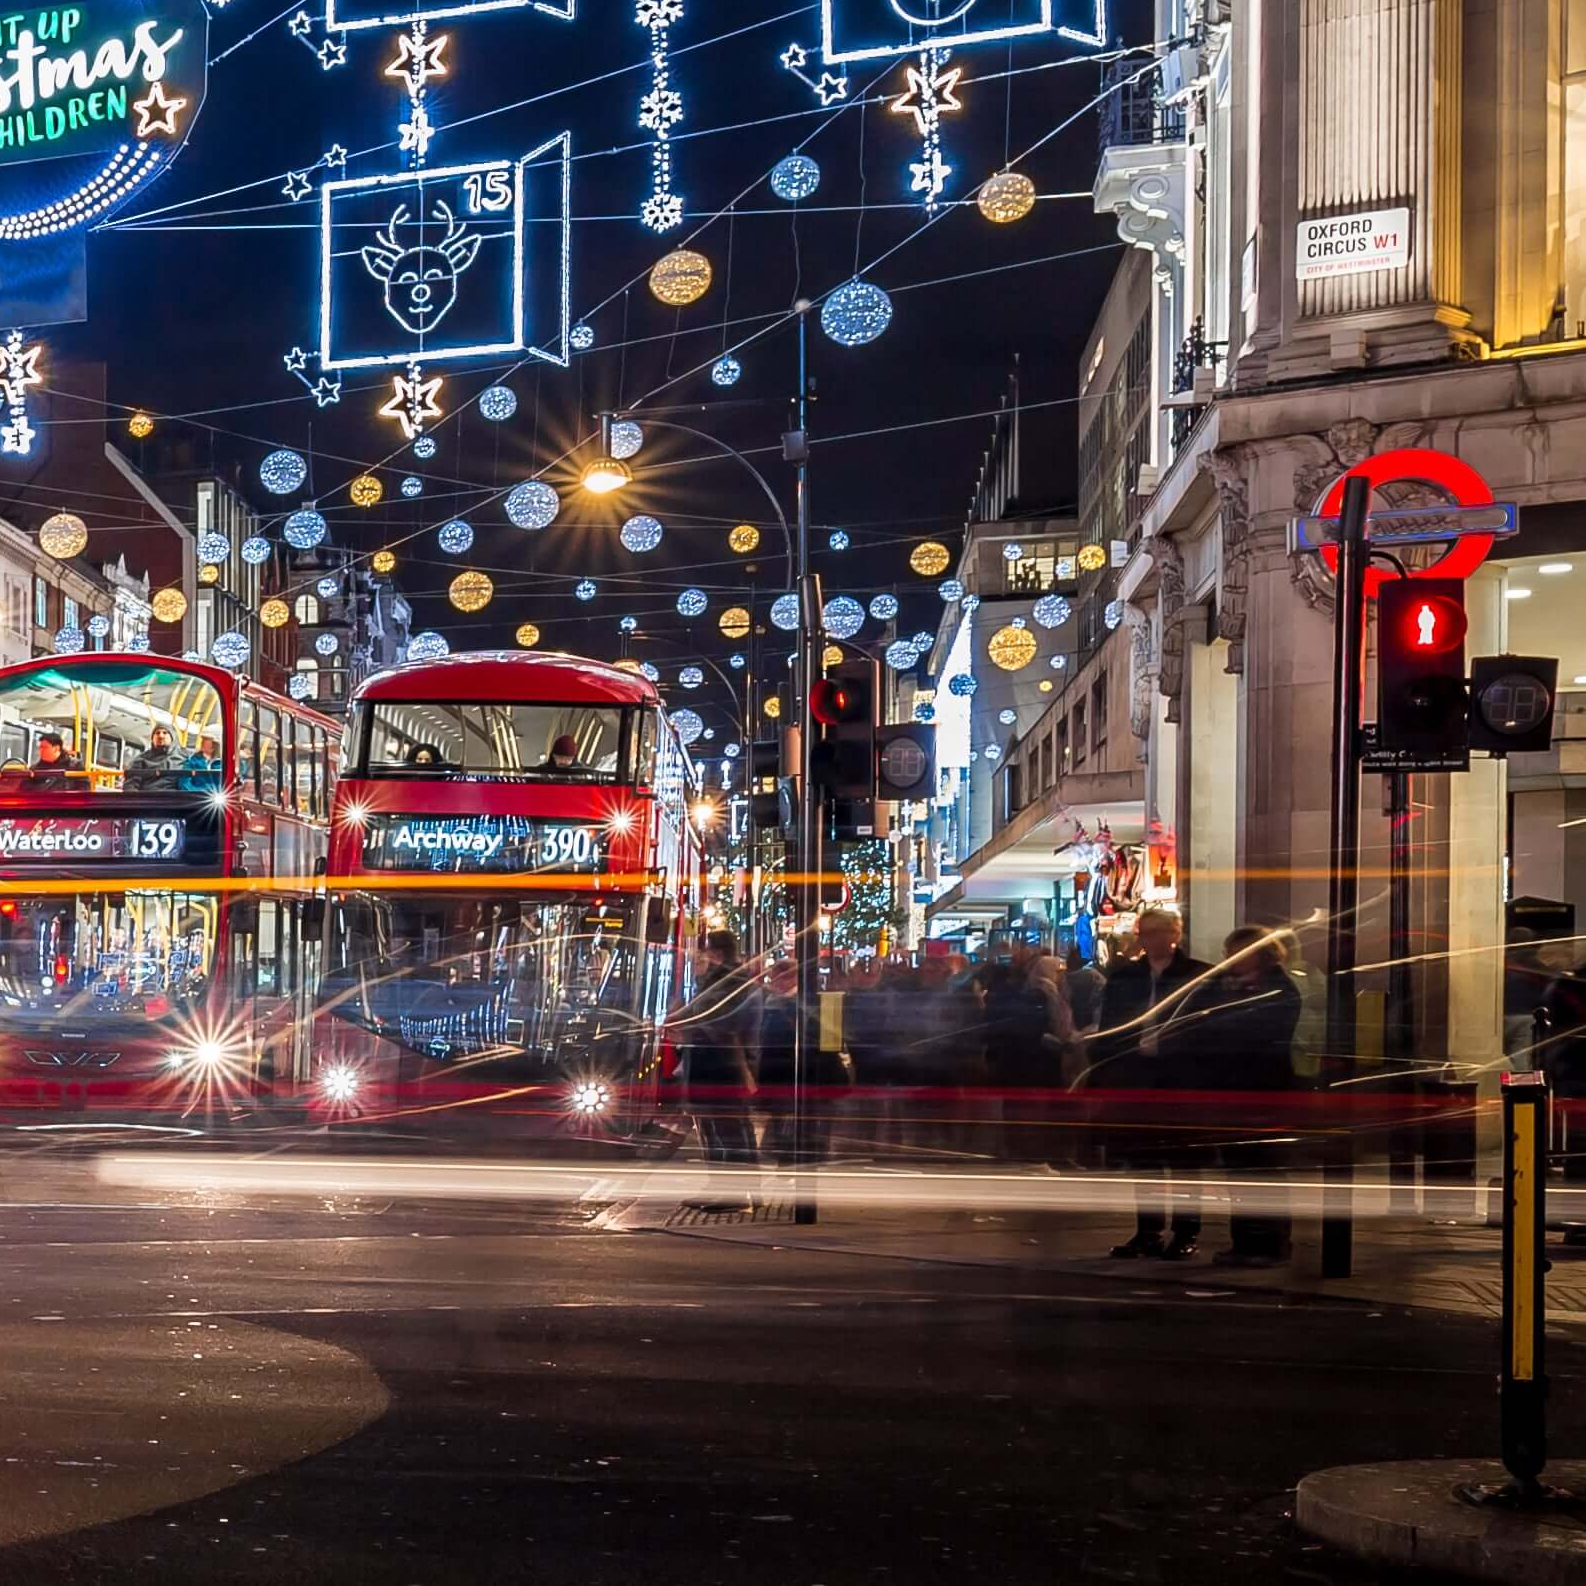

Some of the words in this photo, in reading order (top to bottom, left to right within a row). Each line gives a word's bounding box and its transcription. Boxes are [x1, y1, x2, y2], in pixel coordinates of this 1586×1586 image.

[38, 7, 80, 44] UP
[463, 171, 513, 214] 15
[1307, 237, 1367, 258] CIRCUS
[1373, 233, 1397, 249] W1
[1308, 218, 1373, 241] OXFORD
[131, 822, 179, 856] 139
[393, 825, 503, 856] Archway
[541, 828, 591, 863] 390
